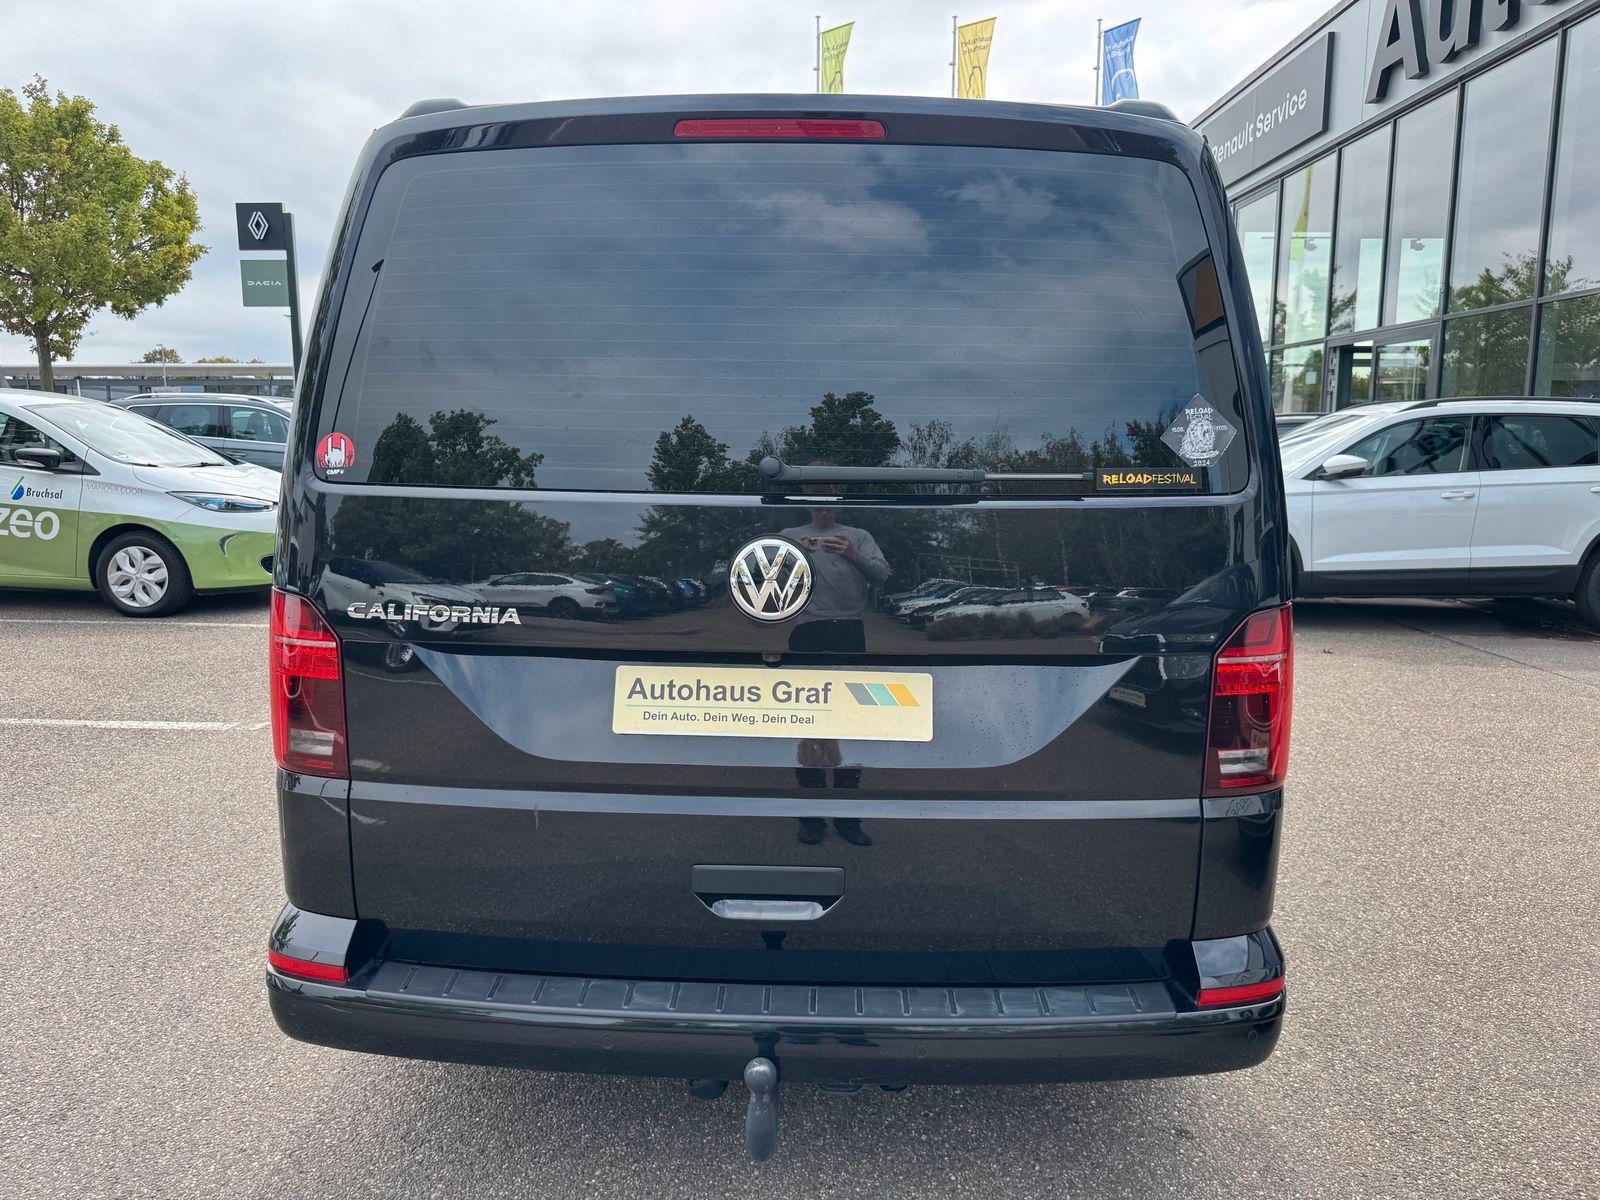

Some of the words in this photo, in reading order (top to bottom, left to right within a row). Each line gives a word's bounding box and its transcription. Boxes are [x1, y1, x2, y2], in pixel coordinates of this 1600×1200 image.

[1365, 0, 1561, 103] Au
[1211, 121, 1254, 163] Renault
[1256, 88, 1307, 138] Service
[1185, 407, 1214, 416] RELOAD
[26, 487, 63, 500] Bruchsal
[347, 602, 522, 625] CALIFORNIA
[627, 677, 761, 702] Autohaus
[772, 680, 833, 704] Graf
[643, 711, 667, 721] Dein
[670, 712, 700, 722] Auto.
[703, 712, 728, 722] Dein
[731, 713, 759, 725] Weg.
[762, 714, 787, 724] Dein
[790, 715, 815, 725] Deal
